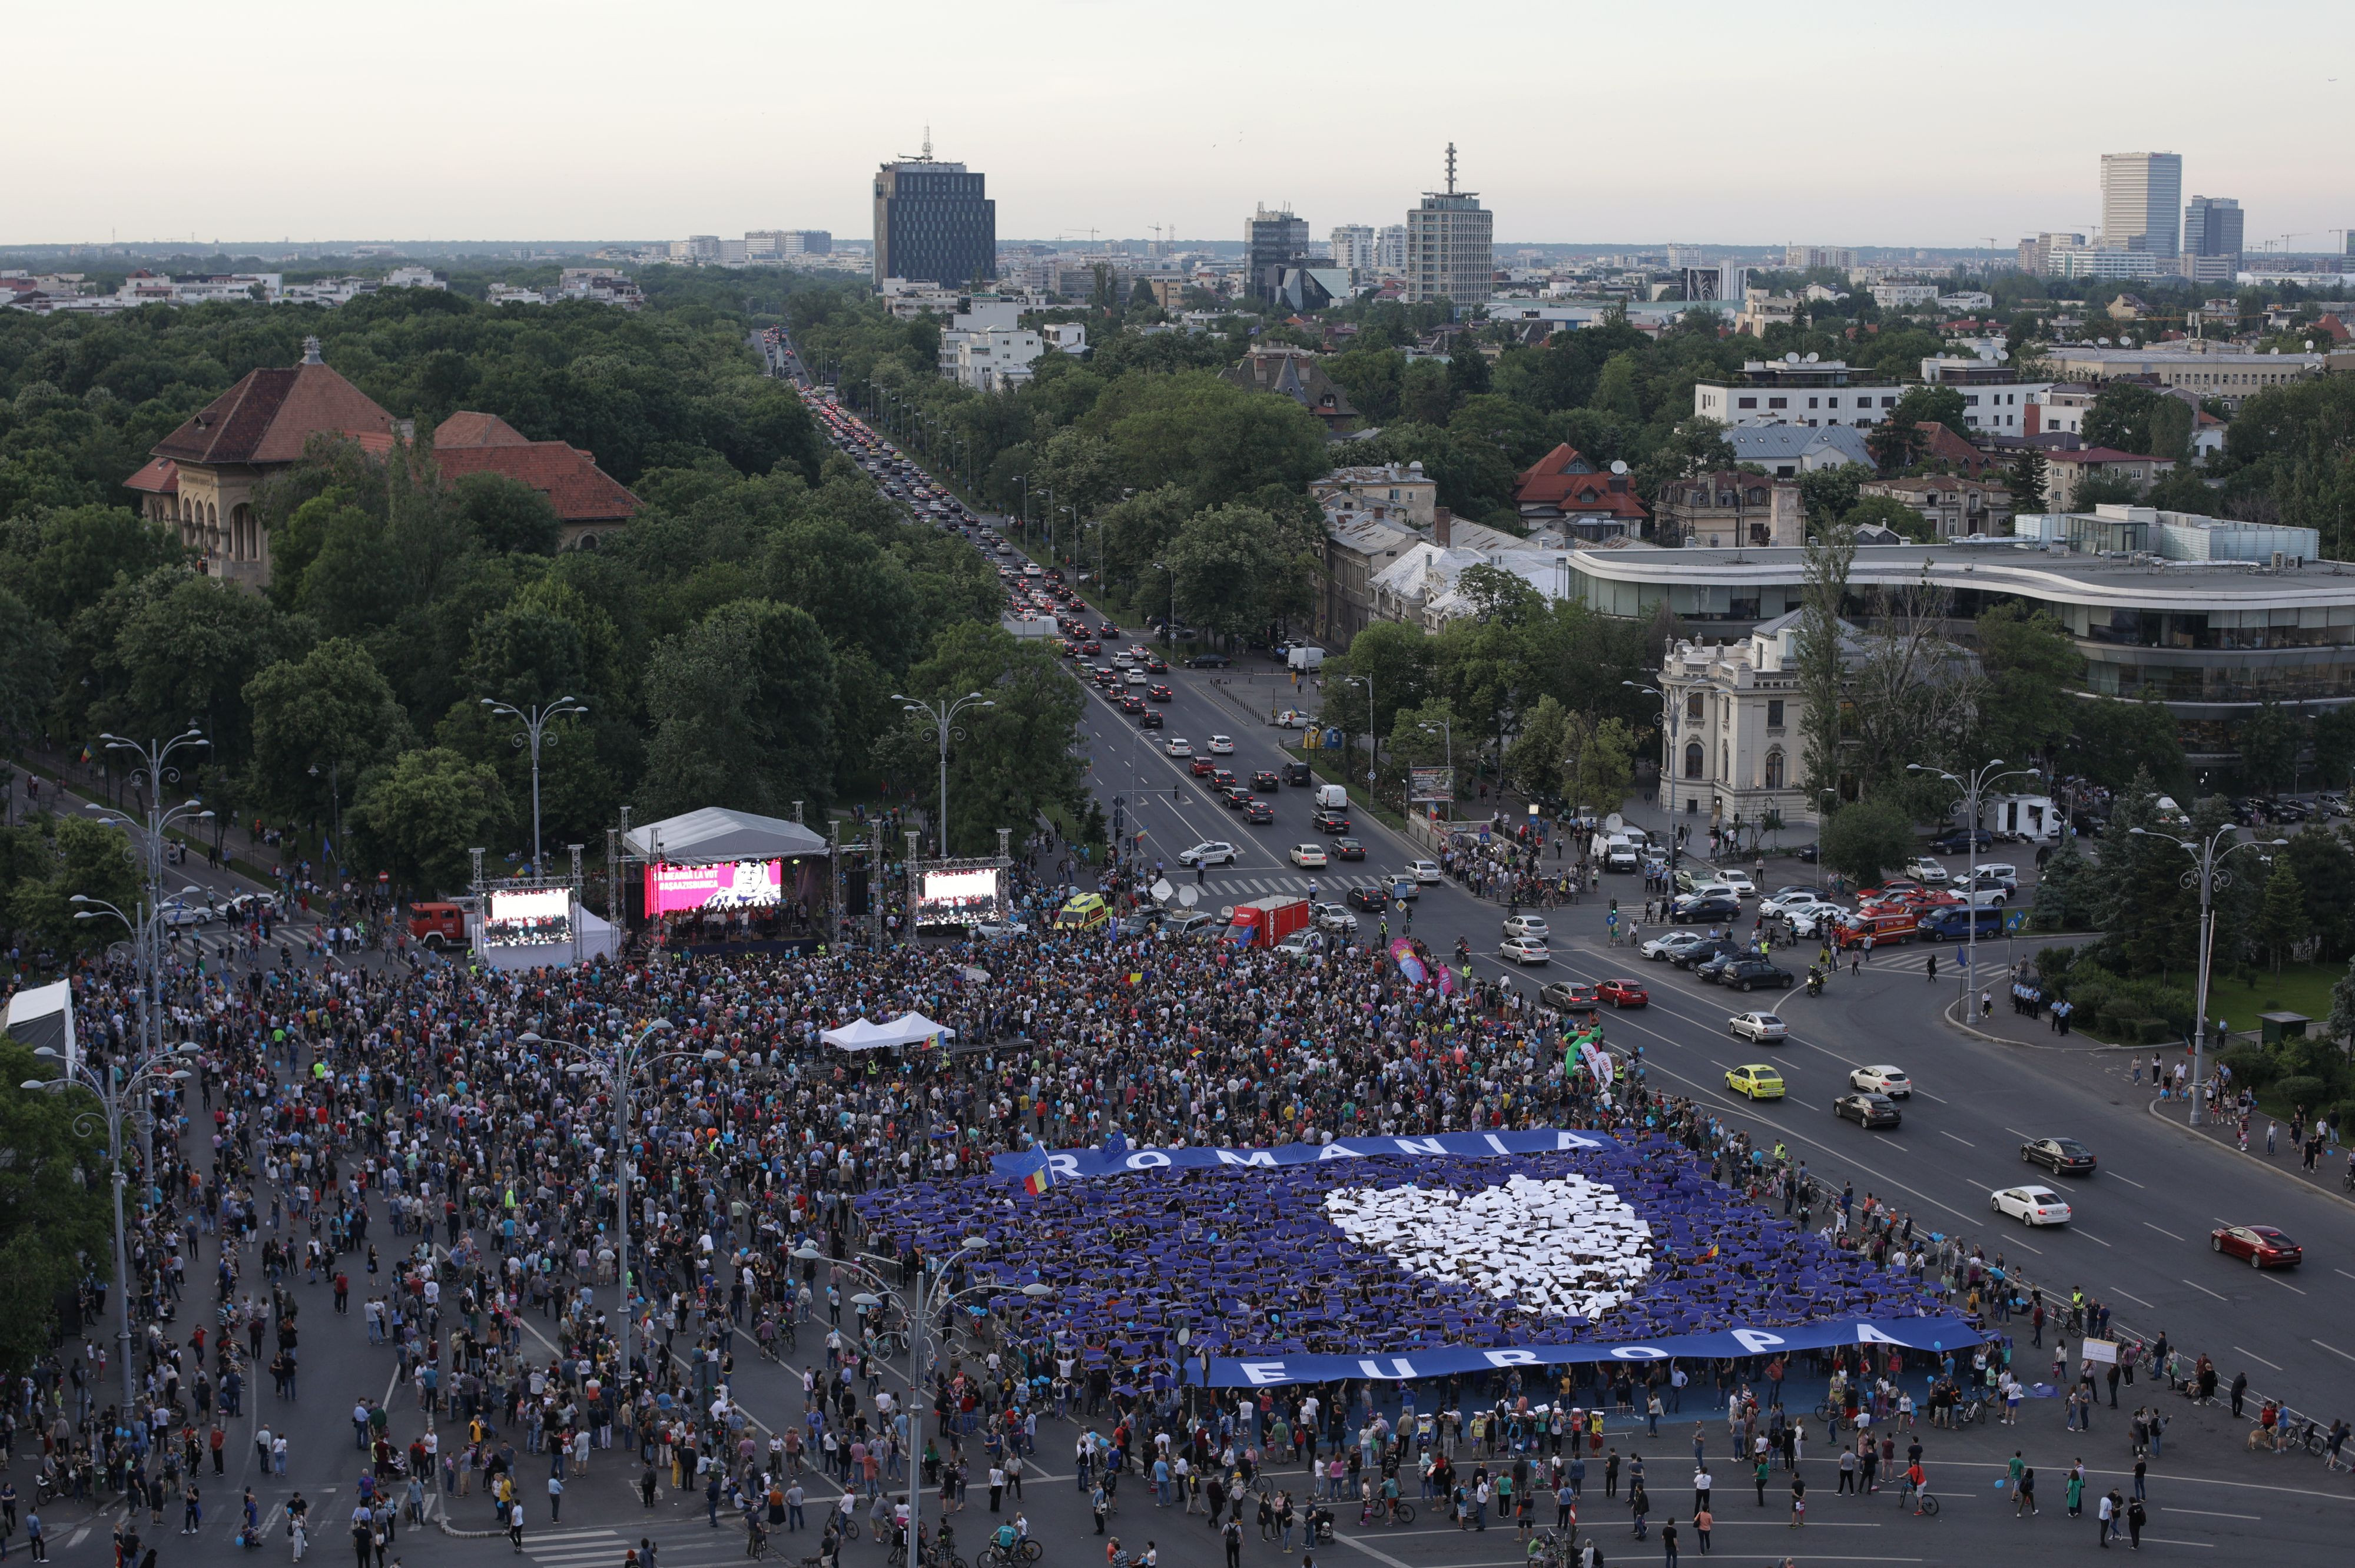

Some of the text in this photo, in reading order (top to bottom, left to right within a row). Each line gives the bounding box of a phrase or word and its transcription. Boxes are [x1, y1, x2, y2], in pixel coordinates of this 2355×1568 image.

[664, 870, 694, 880] MEARGĂ
[694, 871, 704, 879] LA
[705, 870, 718, 879] VOT
[1047, 1132, 1603, 1177] ROMANIA
[1239, 1323, 1912, 1385] EUROPA
